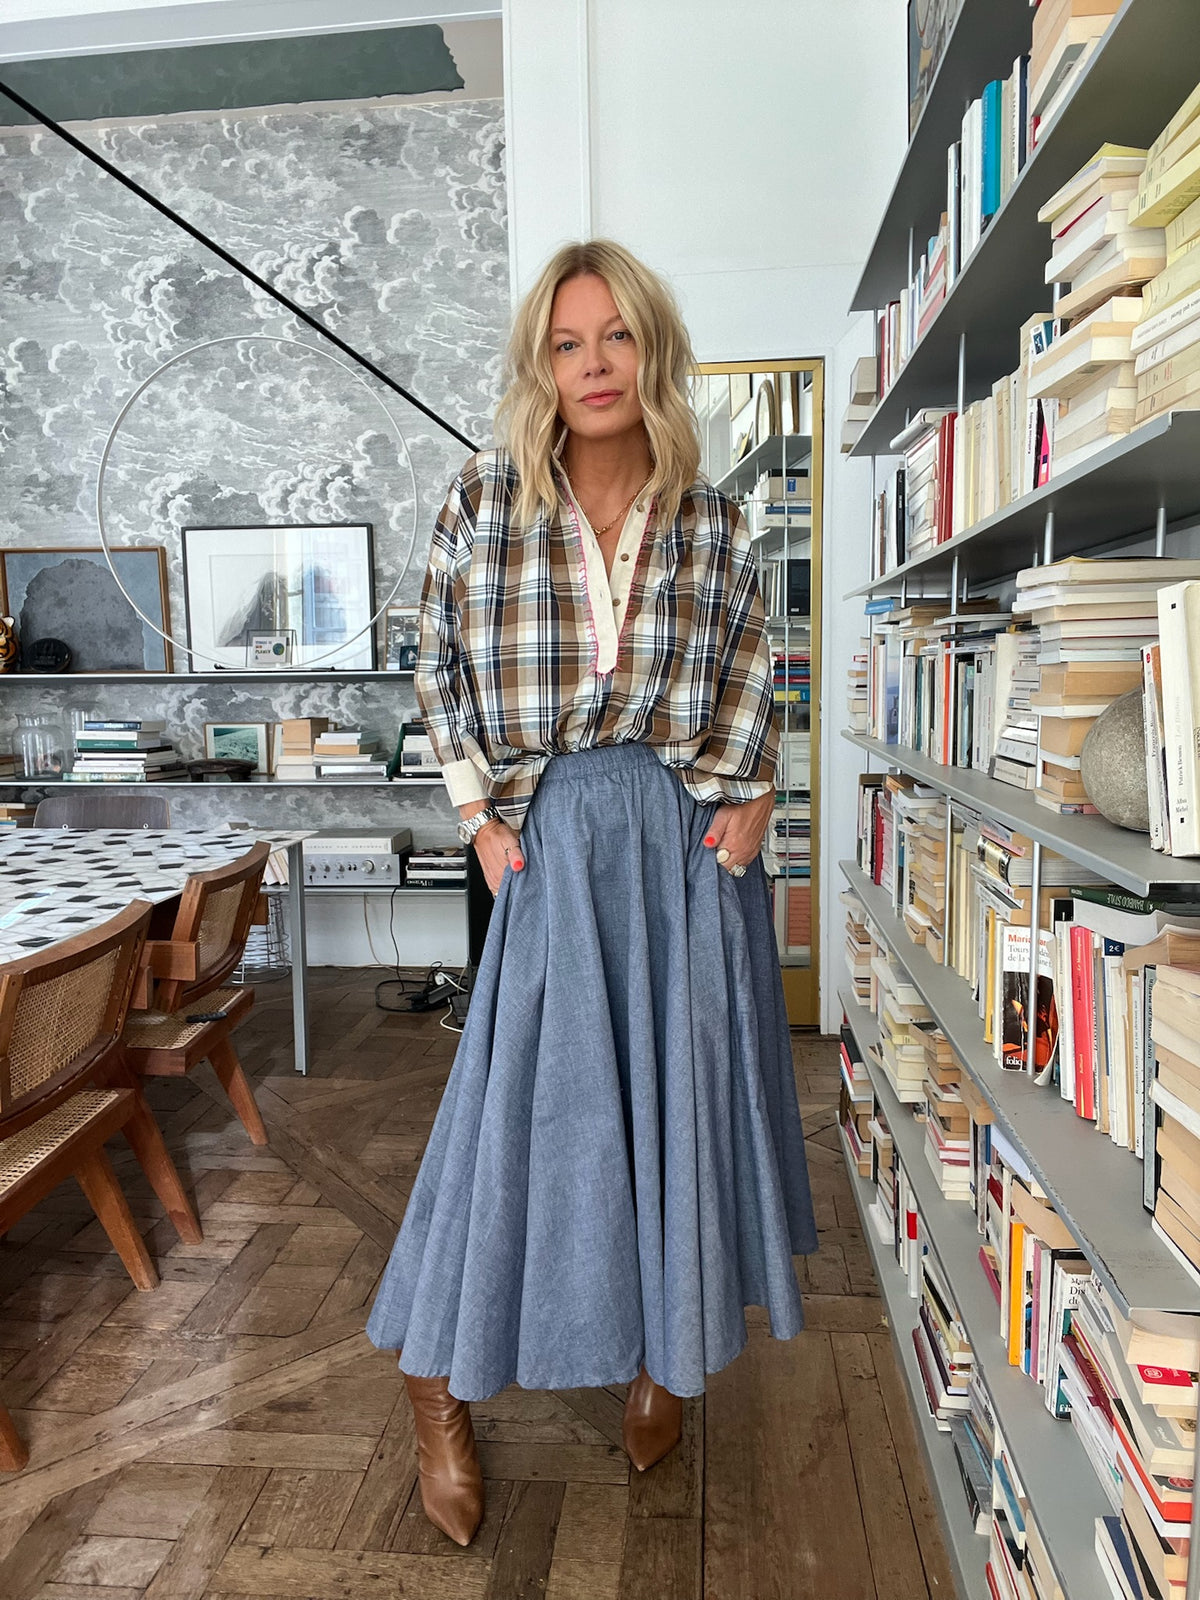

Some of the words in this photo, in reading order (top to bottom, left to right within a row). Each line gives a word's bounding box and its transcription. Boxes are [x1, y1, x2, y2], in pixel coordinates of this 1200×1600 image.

[1107, 893, 1122, 906] STYLE
[1122, 896, 1144, 911] BAMBOO
[1008, 944, 1029, 953] Tours
